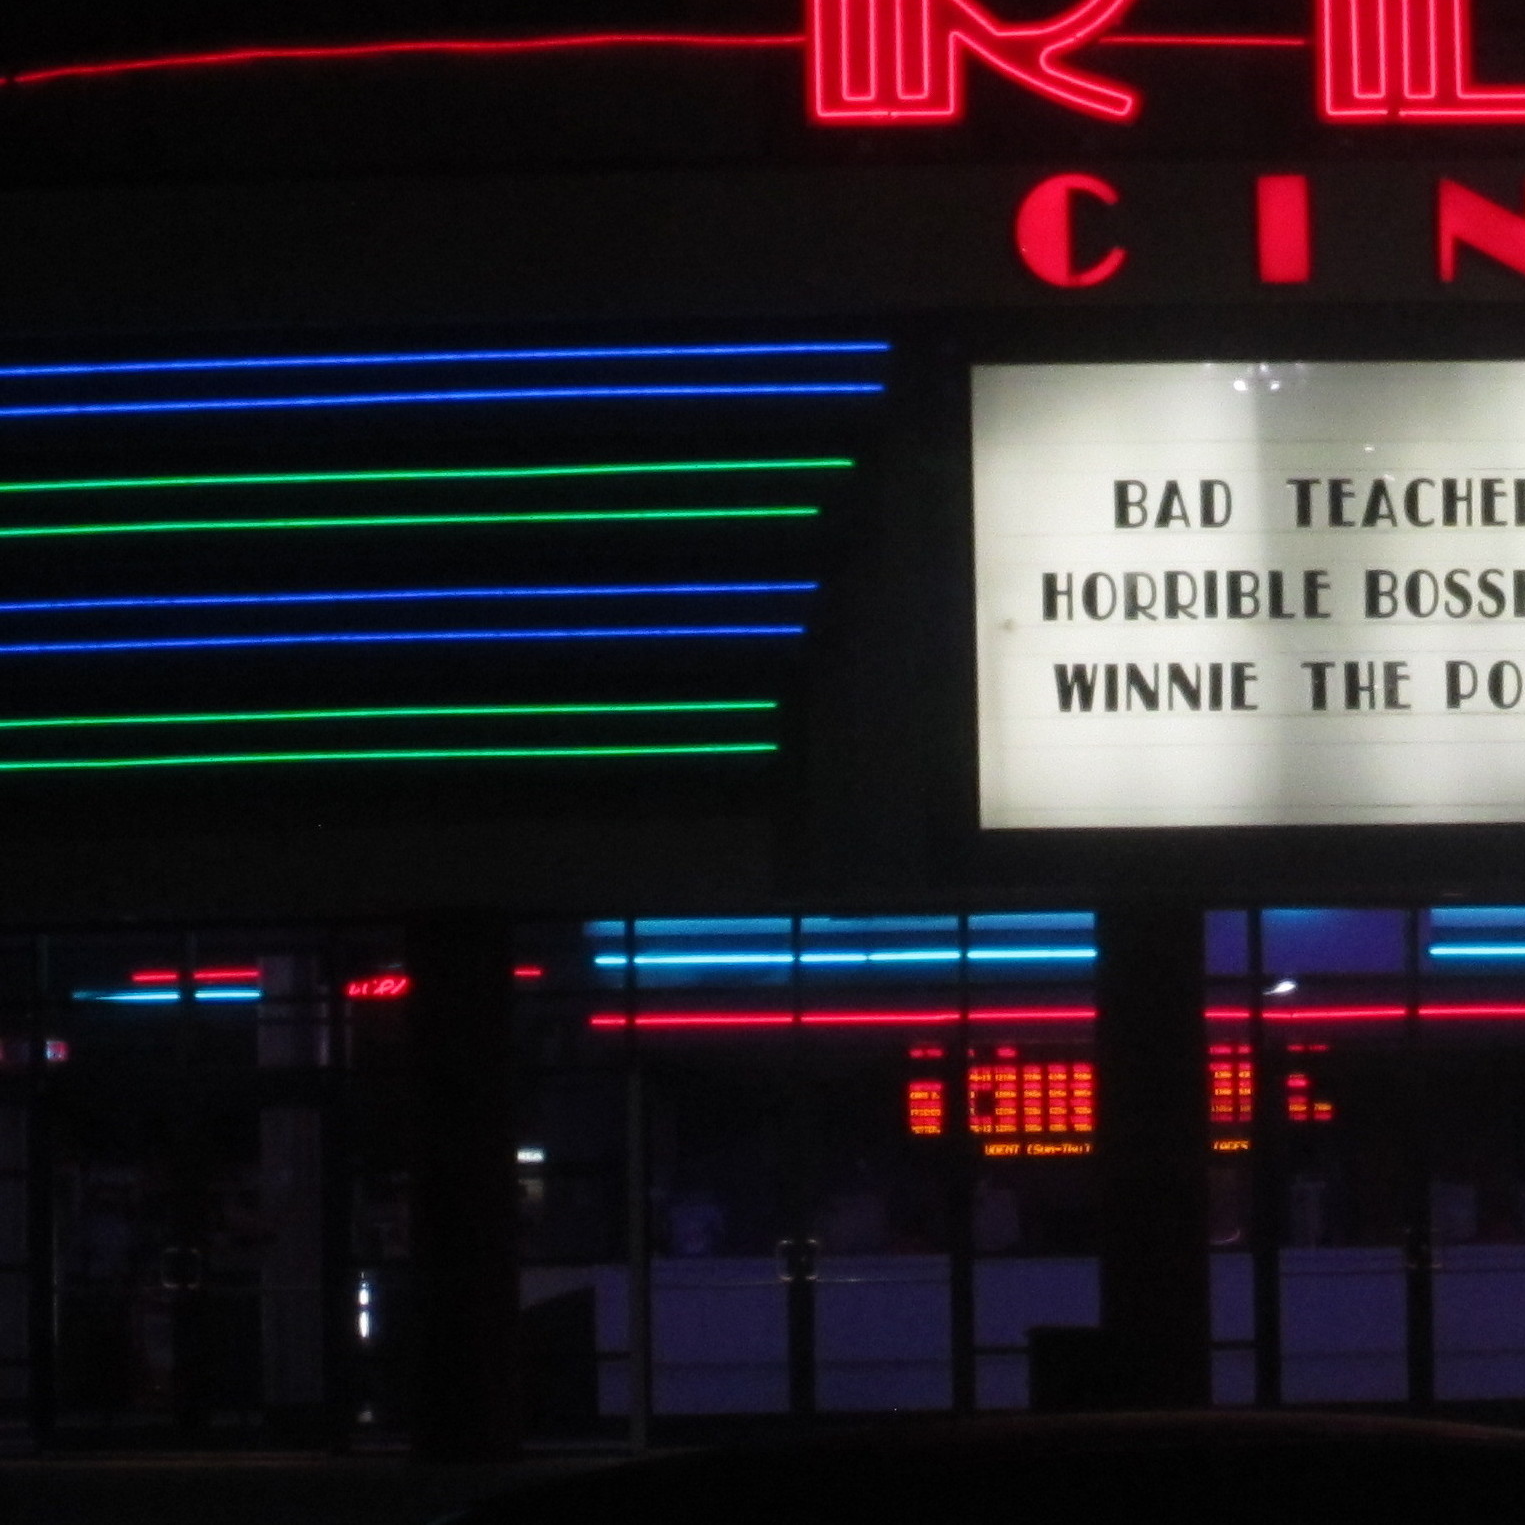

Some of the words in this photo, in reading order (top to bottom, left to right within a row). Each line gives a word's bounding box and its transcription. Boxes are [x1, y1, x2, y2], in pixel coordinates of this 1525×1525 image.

[1113, 478, 1233, 529] BAD
[1041, 569, 1333, 621] HORRIBLE
[1053, 662, 1259, 712] WINNIE
[1300, 661, 1412, 711] THE
